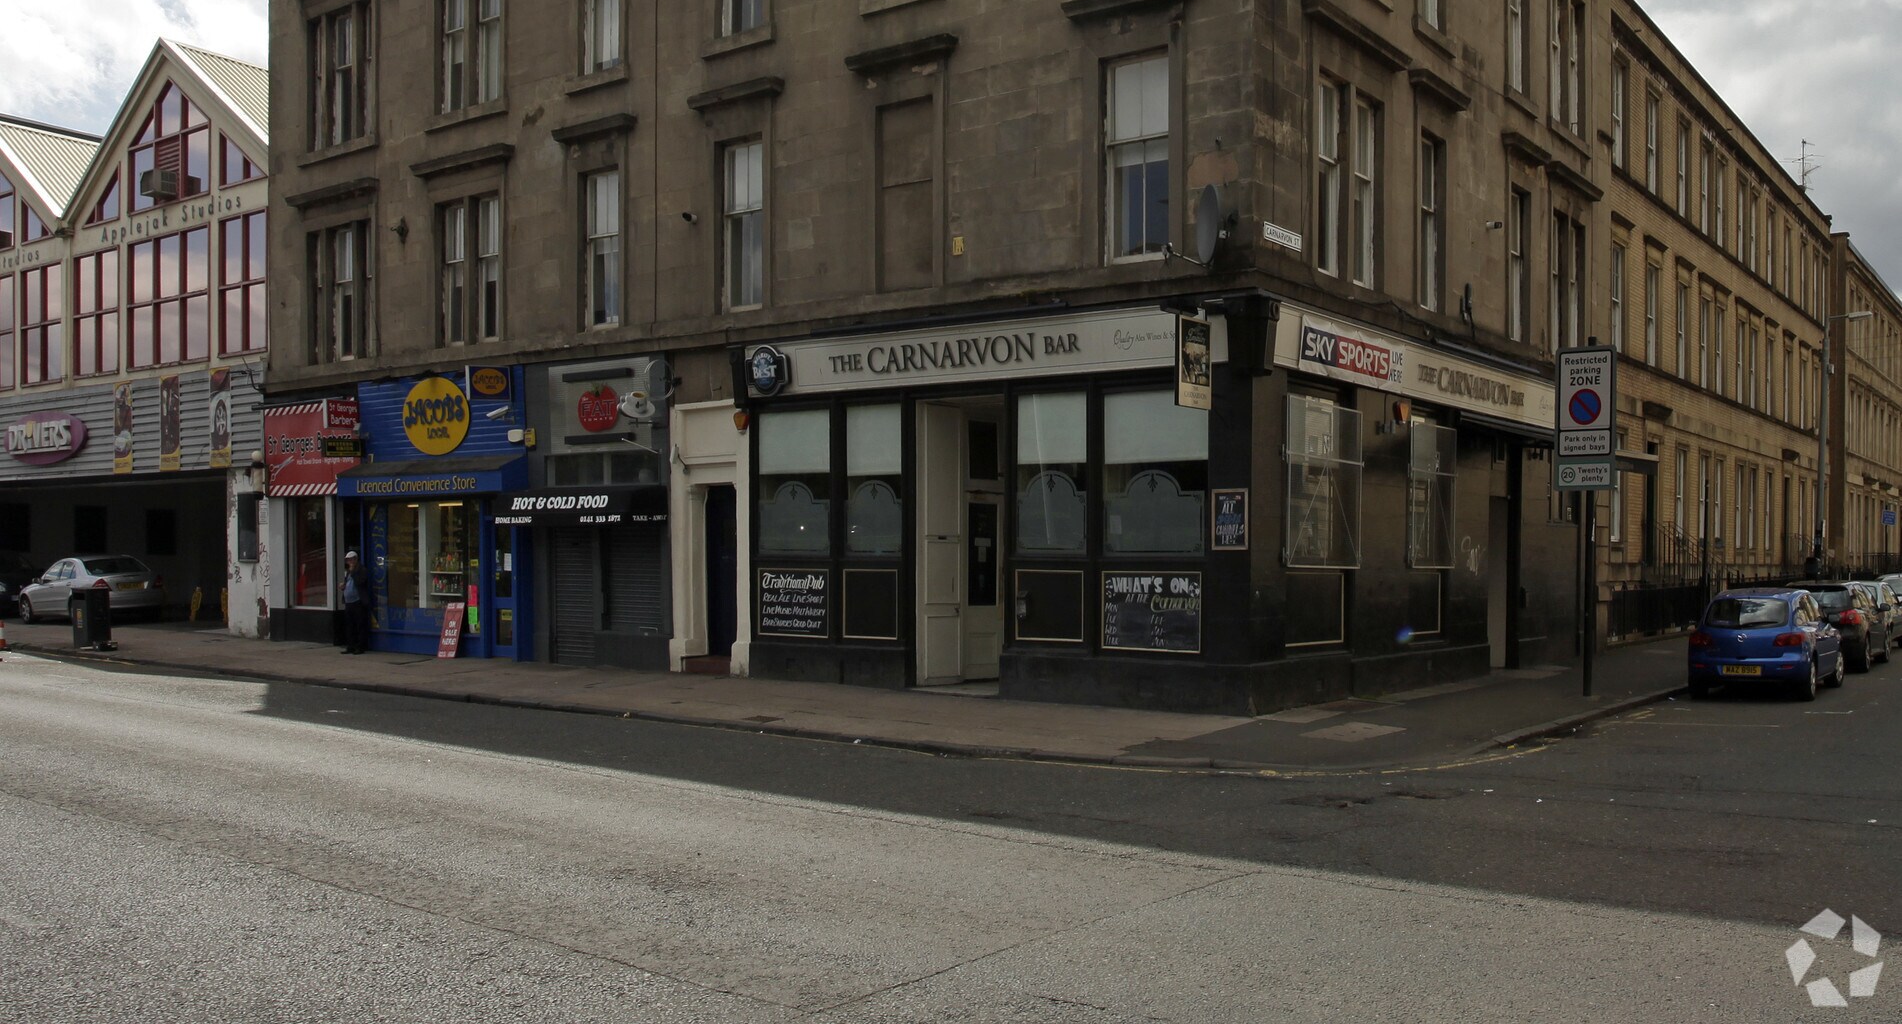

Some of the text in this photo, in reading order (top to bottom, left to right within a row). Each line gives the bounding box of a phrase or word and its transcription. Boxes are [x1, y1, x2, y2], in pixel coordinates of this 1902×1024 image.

[101, 195, 242, 242] Applejak Studios
[829, 332, 1080, 374] THE CARNARVON BAR
[1304, 332, 1388, 375] SKY SPORTS
[1391, 351, 1403, 366] LIVE
[1564, 356, 1607, 365] Restricted
[752, 364, 777, 379] BEST
[1570, 367, 1601, 376] parking
[1418, 363, 1438, 385] THE
[1437, 367, 1511, 406] CARNARVON
[1570, 376, 1601, 386] ZONE
[336, 404, 357, 414] Georges
[404, 393, 465, 428] JACOBS
[581, 399, 614, 417] FAT
[330, 415, 356, 425] Barbers
[8, 419, 72, 452] DRIVERS
[1582, 435, 1597, 444] only
[281, 434, 315, 457] Georges
[1564, 442, 1605, 452] signed bays
[1563, 467, 1608, 479] 20 Twenty's
[1581, 475, 1604, 483] plenty
[356, 476, 476, 493] Licenced Convenience Store
[511, 495, 609, 510] HOT & COLD FOOD
[511, 516, 532, 524] BAKING
[762, 572, 824, 590] Traditional Pub
[1112, 576, 1189, 594] WHAT'S ON
